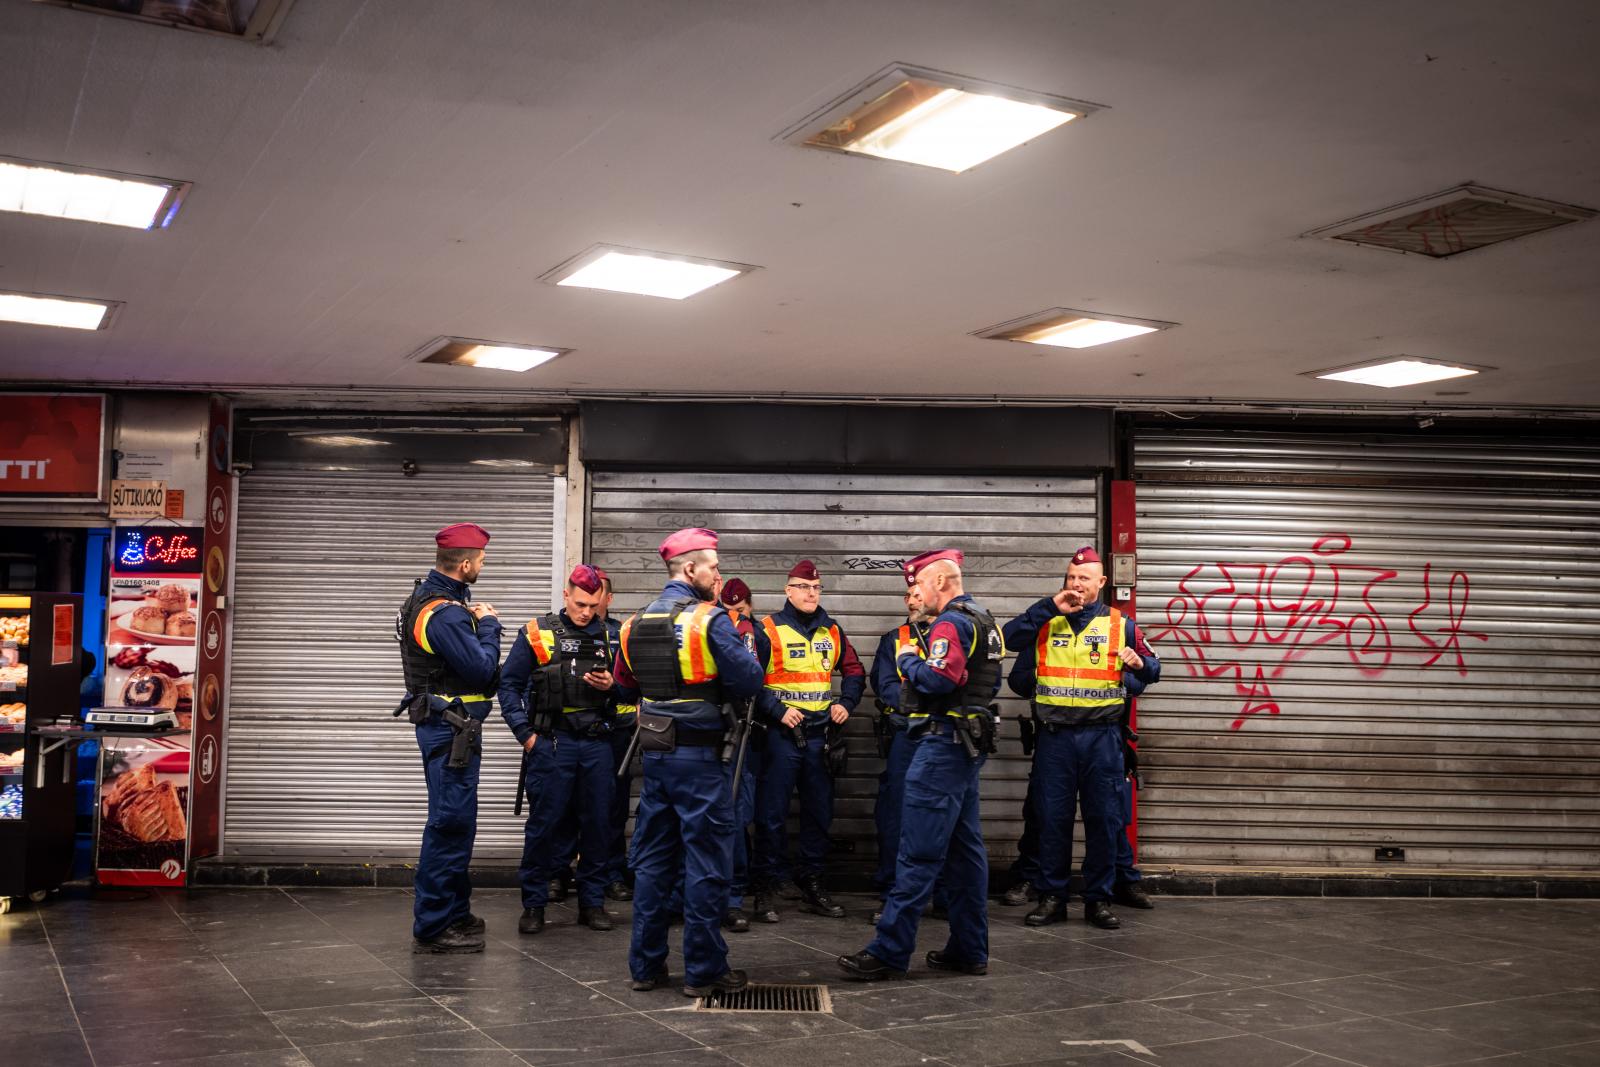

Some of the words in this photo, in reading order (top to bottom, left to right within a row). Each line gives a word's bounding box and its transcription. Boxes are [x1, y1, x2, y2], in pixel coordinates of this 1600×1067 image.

[112, 483, 163, 507] SÜTIKUCKÓ
[145, 535, 198, 563] Coffee
[780, 691, 814, 700] POLICE
[1046, 687, 1081, 696] POLICE
